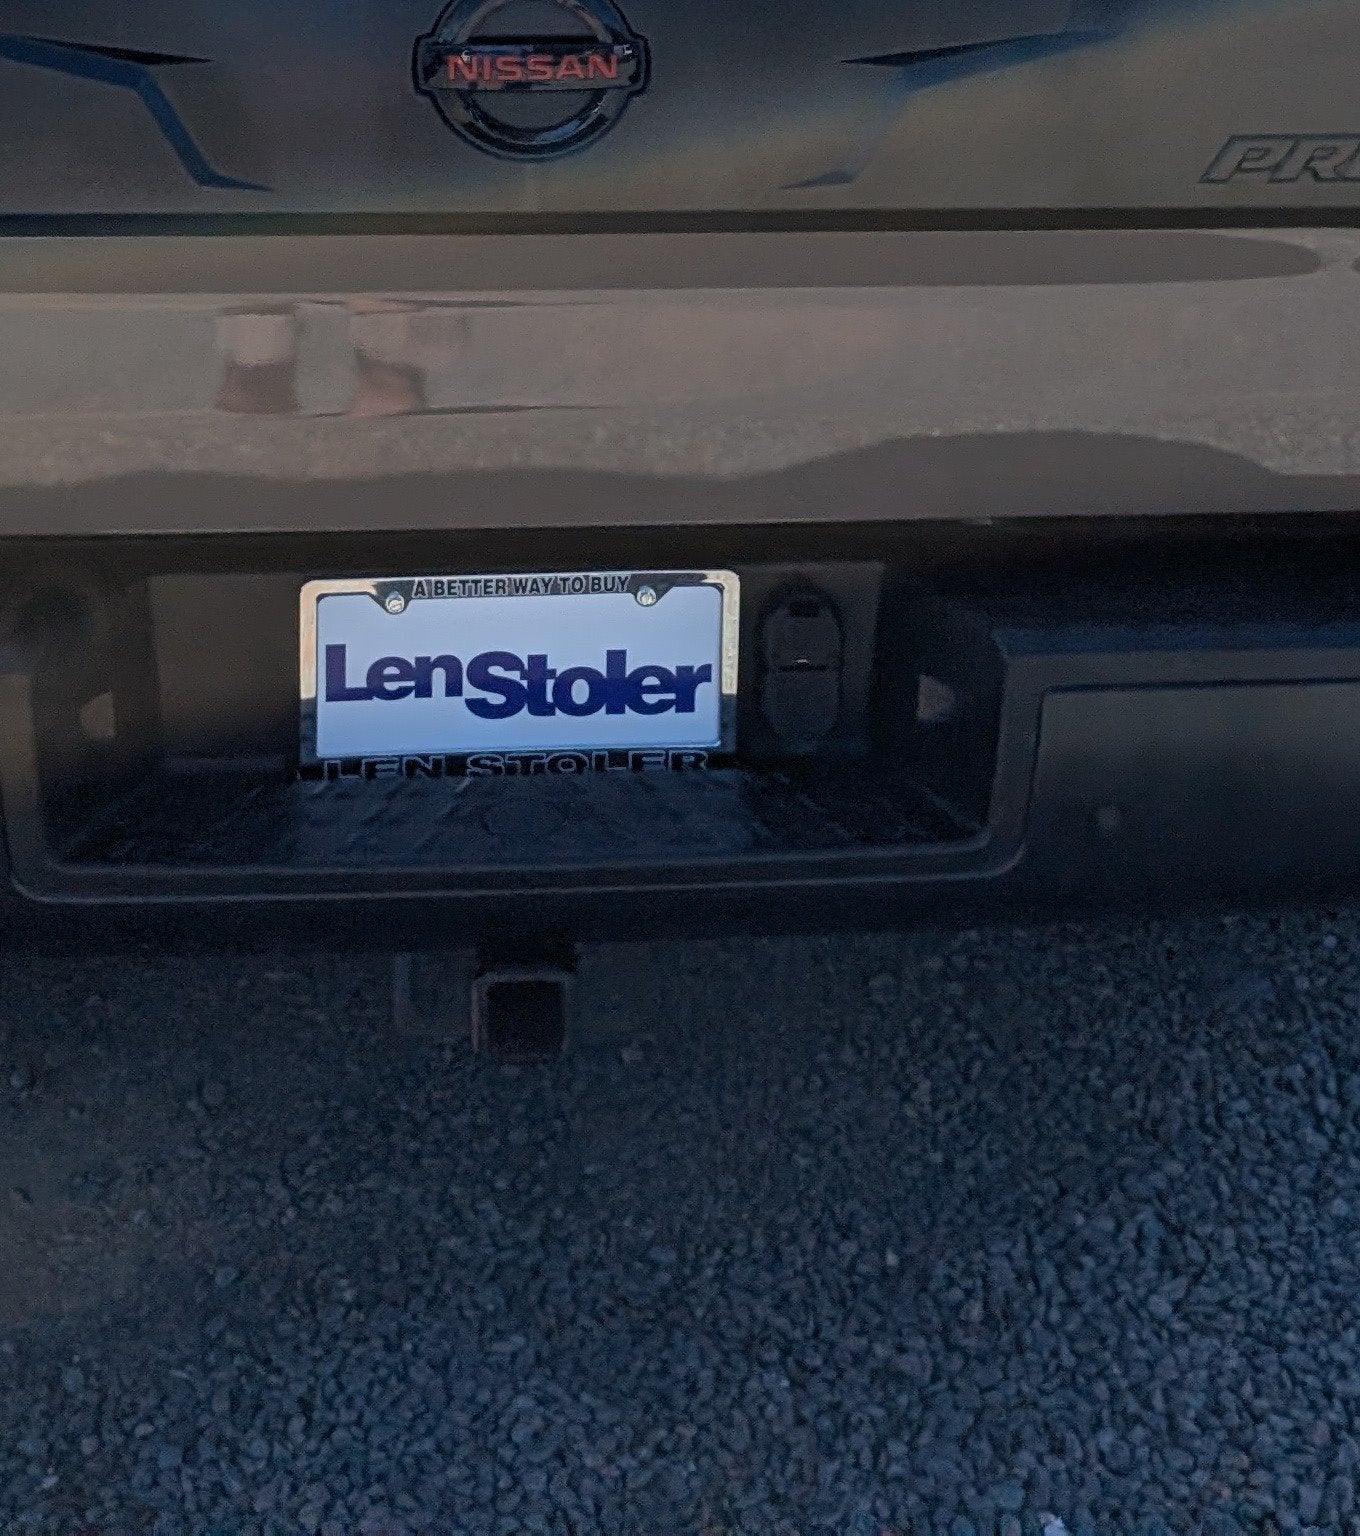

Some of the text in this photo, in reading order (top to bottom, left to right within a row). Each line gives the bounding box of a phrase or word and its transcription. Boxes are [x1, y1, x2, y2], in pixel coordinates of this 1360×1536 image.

[446, 54, 618, 81] NISSAN
[412, 573, 631, 597] A BETTER WAY TO BUY
